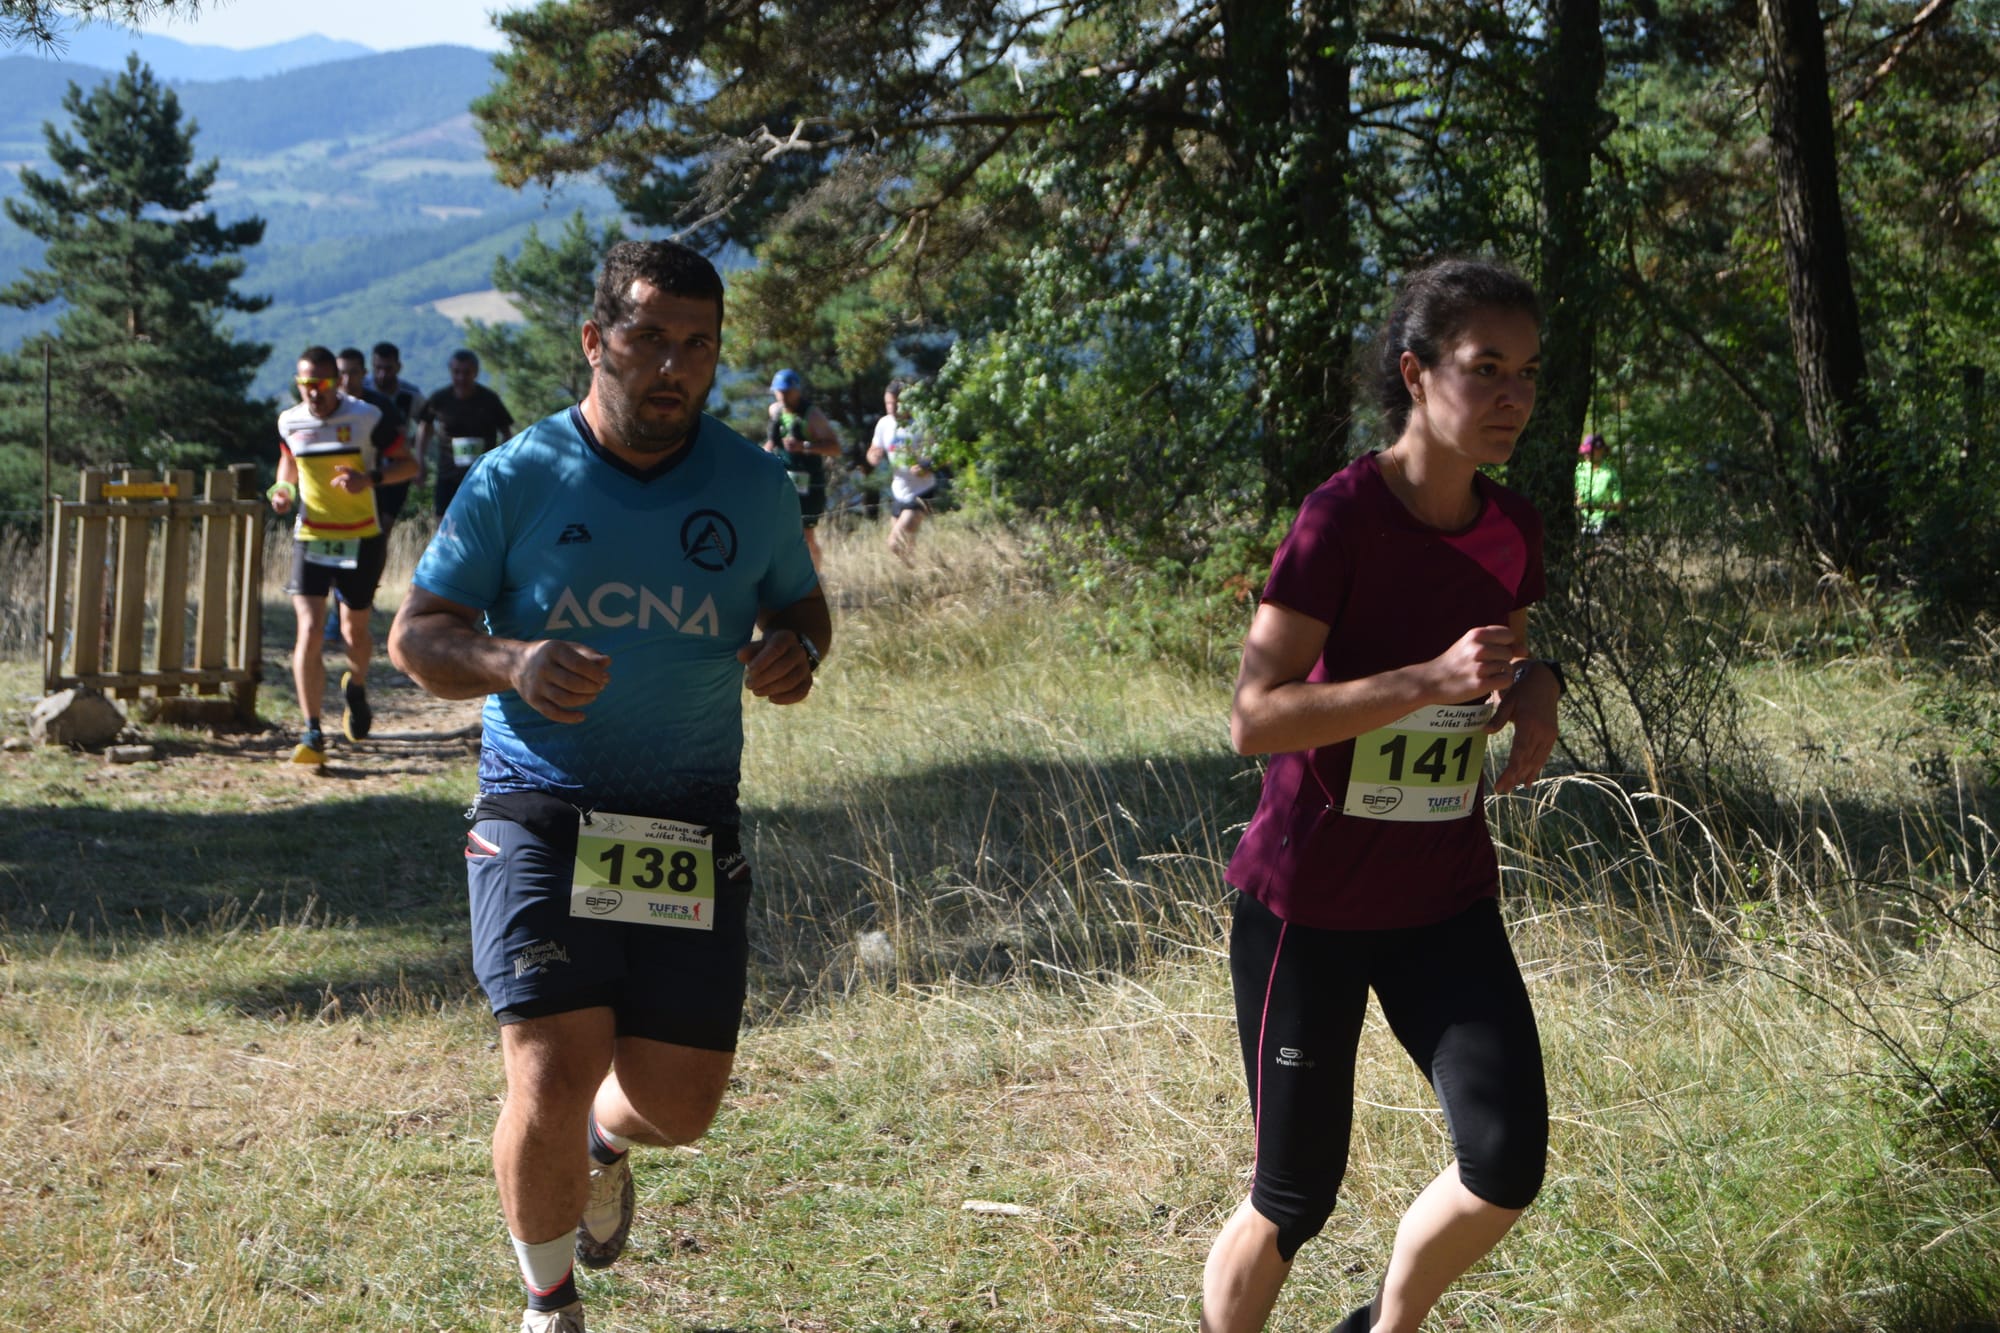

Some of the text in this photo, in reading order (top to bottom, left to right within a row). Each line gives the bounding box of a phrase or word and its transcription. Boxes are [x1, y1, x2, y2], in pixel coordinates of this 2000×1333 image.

[544, 582, 719, 636] ACNA
[1436, 709, 1476, 723] Challenge
[1379, 734, 1473, 783] 141
[1362, 794, 1397, 805] BFP
[1427, 796, 1461, 808] TUFF'S
[650, 822, 689, 836] Challenge
[600, 844, 698, 893] 138
[585, 896, 617, 908] BFP
[648, 902, 689, 914] TUFF'S
[650, 910, 693, 921] Aventure
